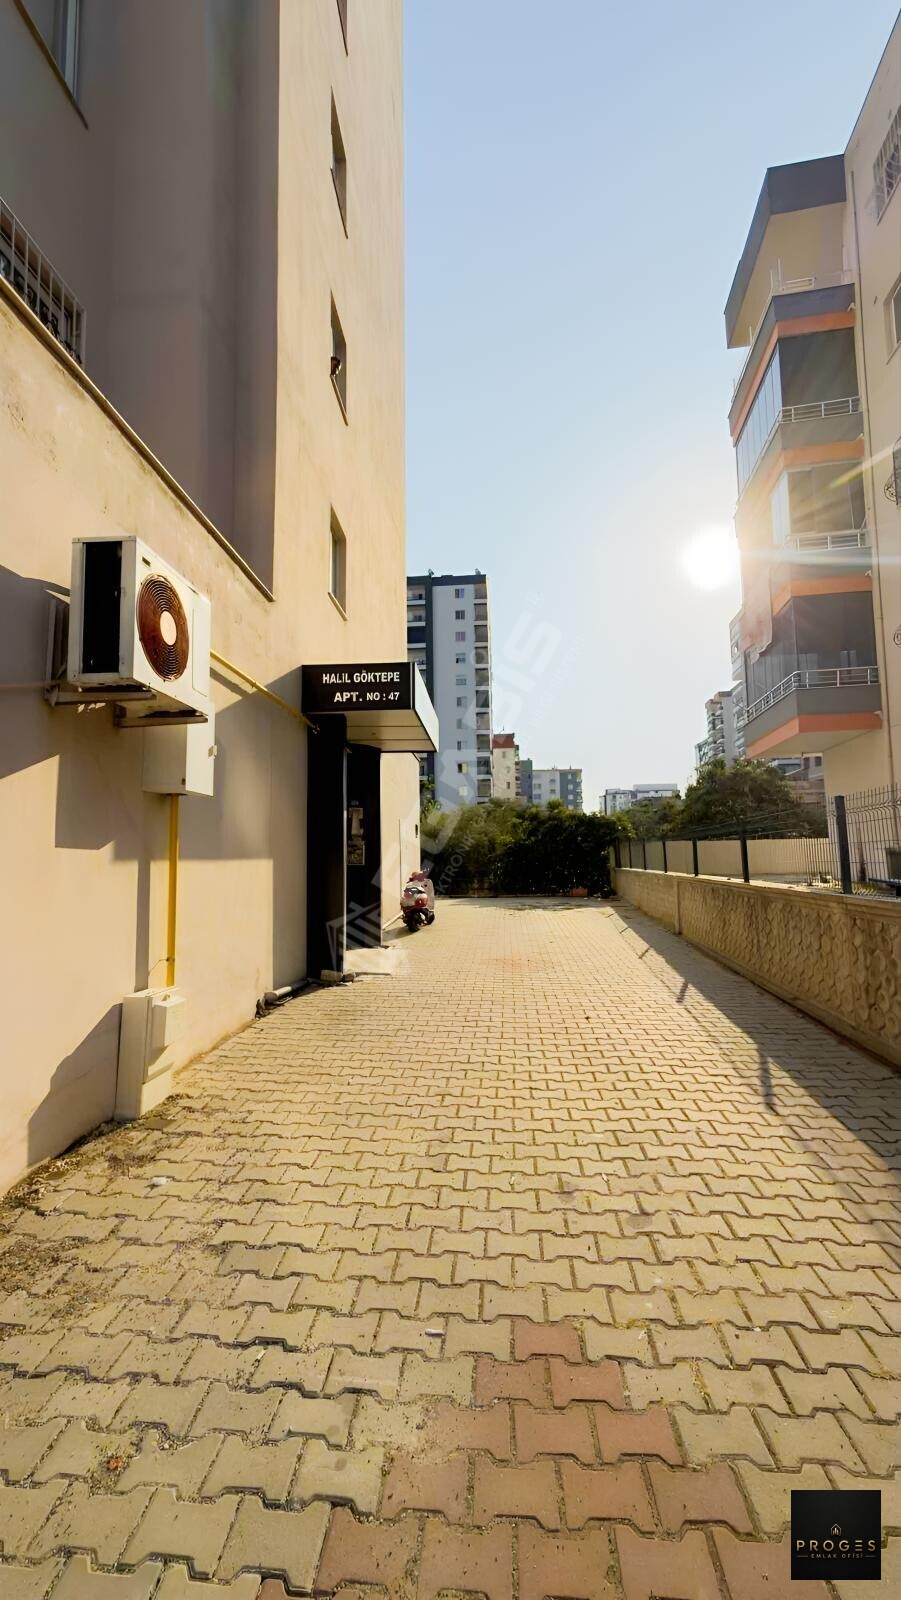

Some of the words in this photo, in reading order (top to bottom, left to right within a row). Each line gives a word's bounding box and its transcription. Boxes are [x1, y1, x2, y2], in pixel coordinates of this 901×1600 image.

[353, 670, 400, 683] GÖKTEPE
[334, 692, 363, 702] APT.
[388, 692, 400, 701] 47
